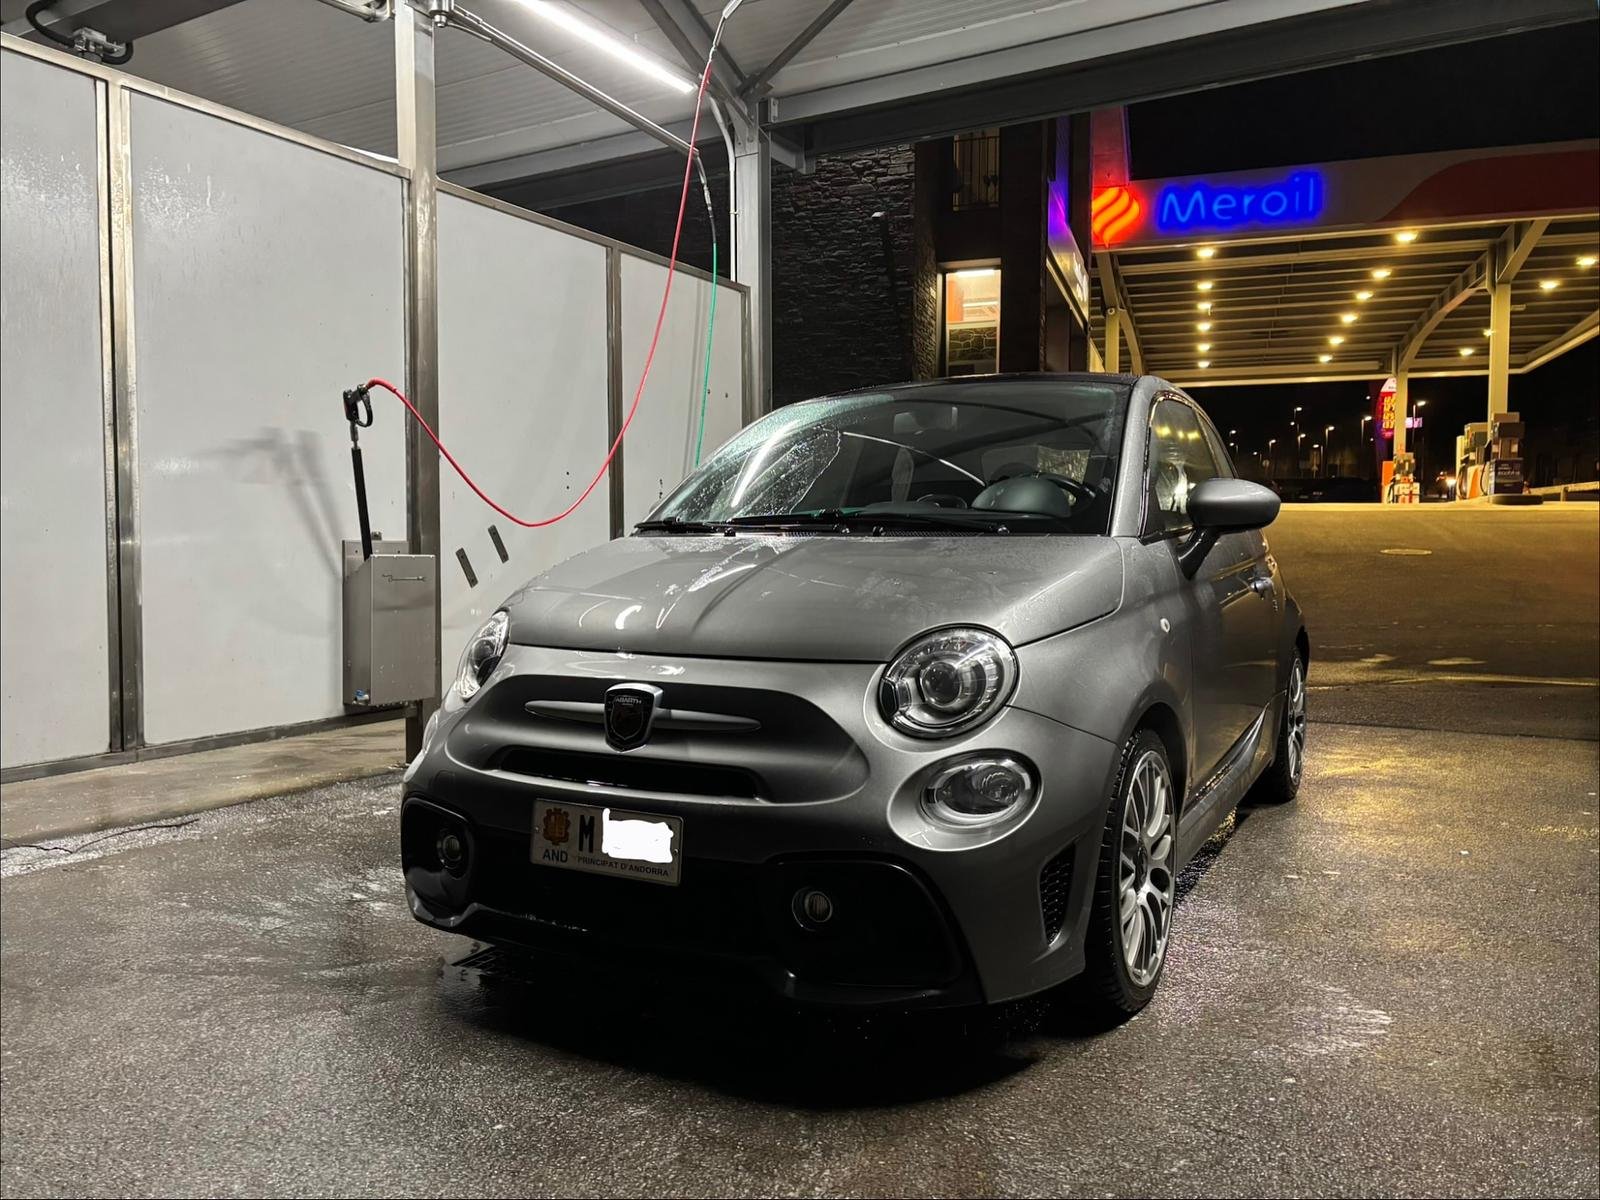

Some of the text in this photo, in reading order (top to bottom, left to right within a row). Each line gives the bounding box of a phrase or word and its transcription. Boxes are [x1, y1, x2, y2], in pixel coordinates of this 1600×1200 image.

[1160, 174, 1318, 226] Meroil
[578, 814, 595, 853] M
[542, 848, 568, 863] AND
[577, 856, 669, 877] PRINCIPAT D'ANDORRA
